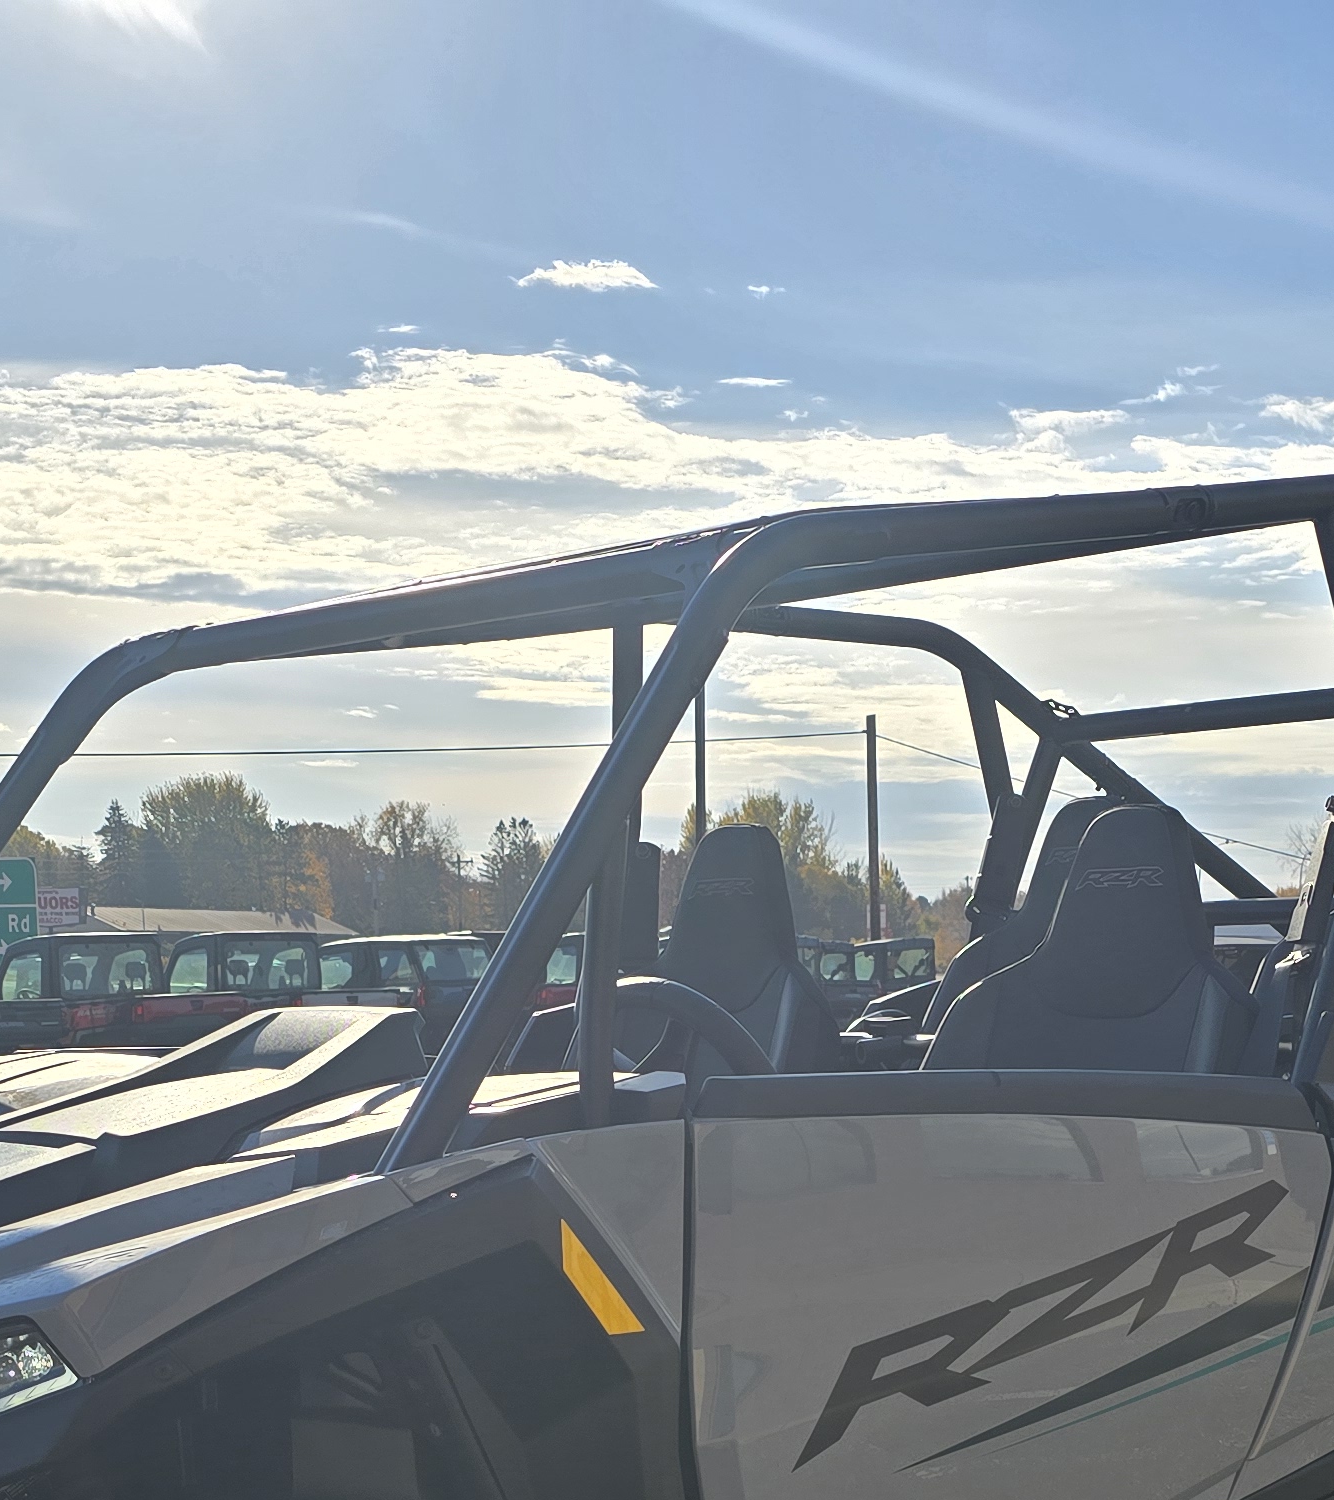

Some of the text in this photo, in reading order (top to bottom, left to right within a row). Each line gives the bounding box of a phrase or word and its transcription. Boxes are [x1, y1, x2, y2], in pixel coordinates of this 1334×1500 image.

[1075, 866, 1165, 891] RZR
[8, 913, 30, 933] Rd
[792, 1179, 1290, 1473] RZR
